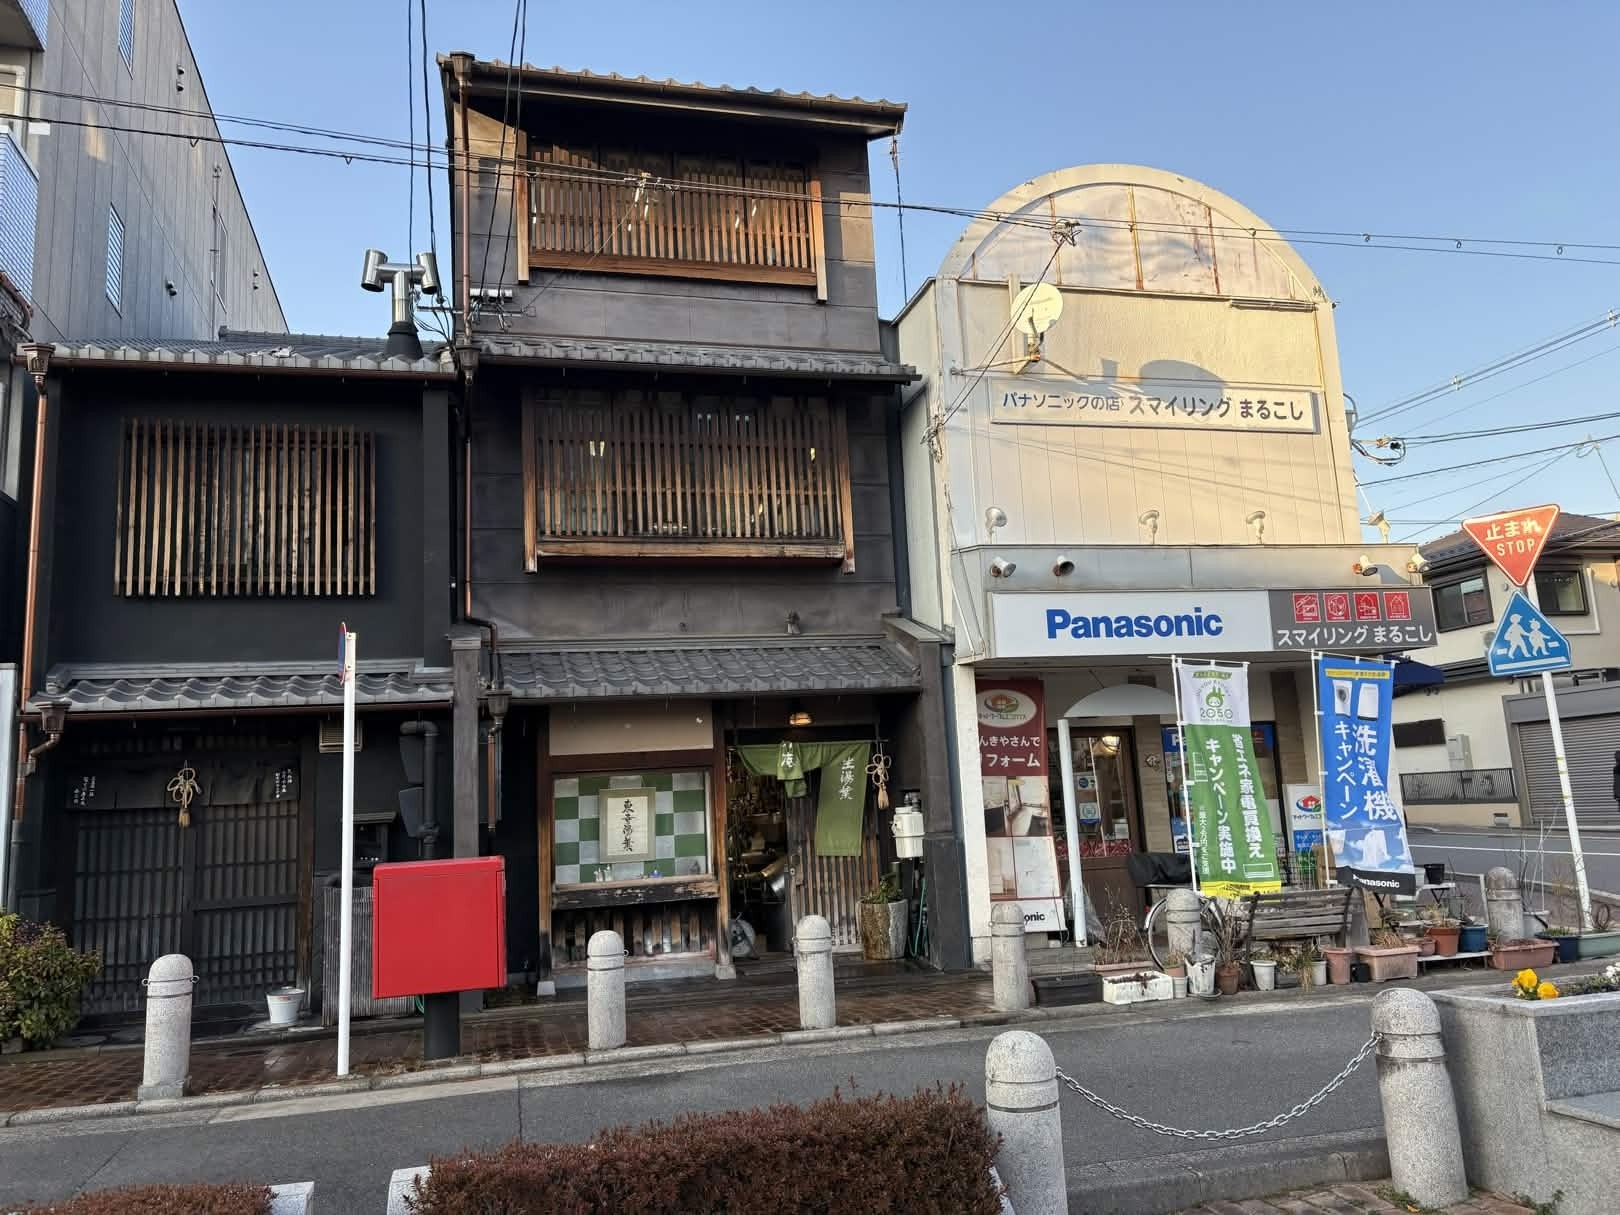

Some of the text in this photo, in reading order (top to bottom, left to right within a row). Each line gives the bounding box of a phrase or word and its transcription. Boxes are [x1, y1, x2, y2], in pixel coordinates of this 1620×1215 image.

[1129, 396, 1232, 417] スマイリング
[1239, 399, 1304, 420] まるこし
[1485, 517, 1542, 541] 止まれ
[1496, 538, 1535, 556] STOP
[1046, 606, 1224, 639] Panasonic
[1276, 624, 1433, 646] スマイリング まるこし
[979, 752, 1041, 768] フォーム
[1334, 720, 1358, 820] キャンペーン
[1205, 738, 1237, 875] キャンペーン実施中
